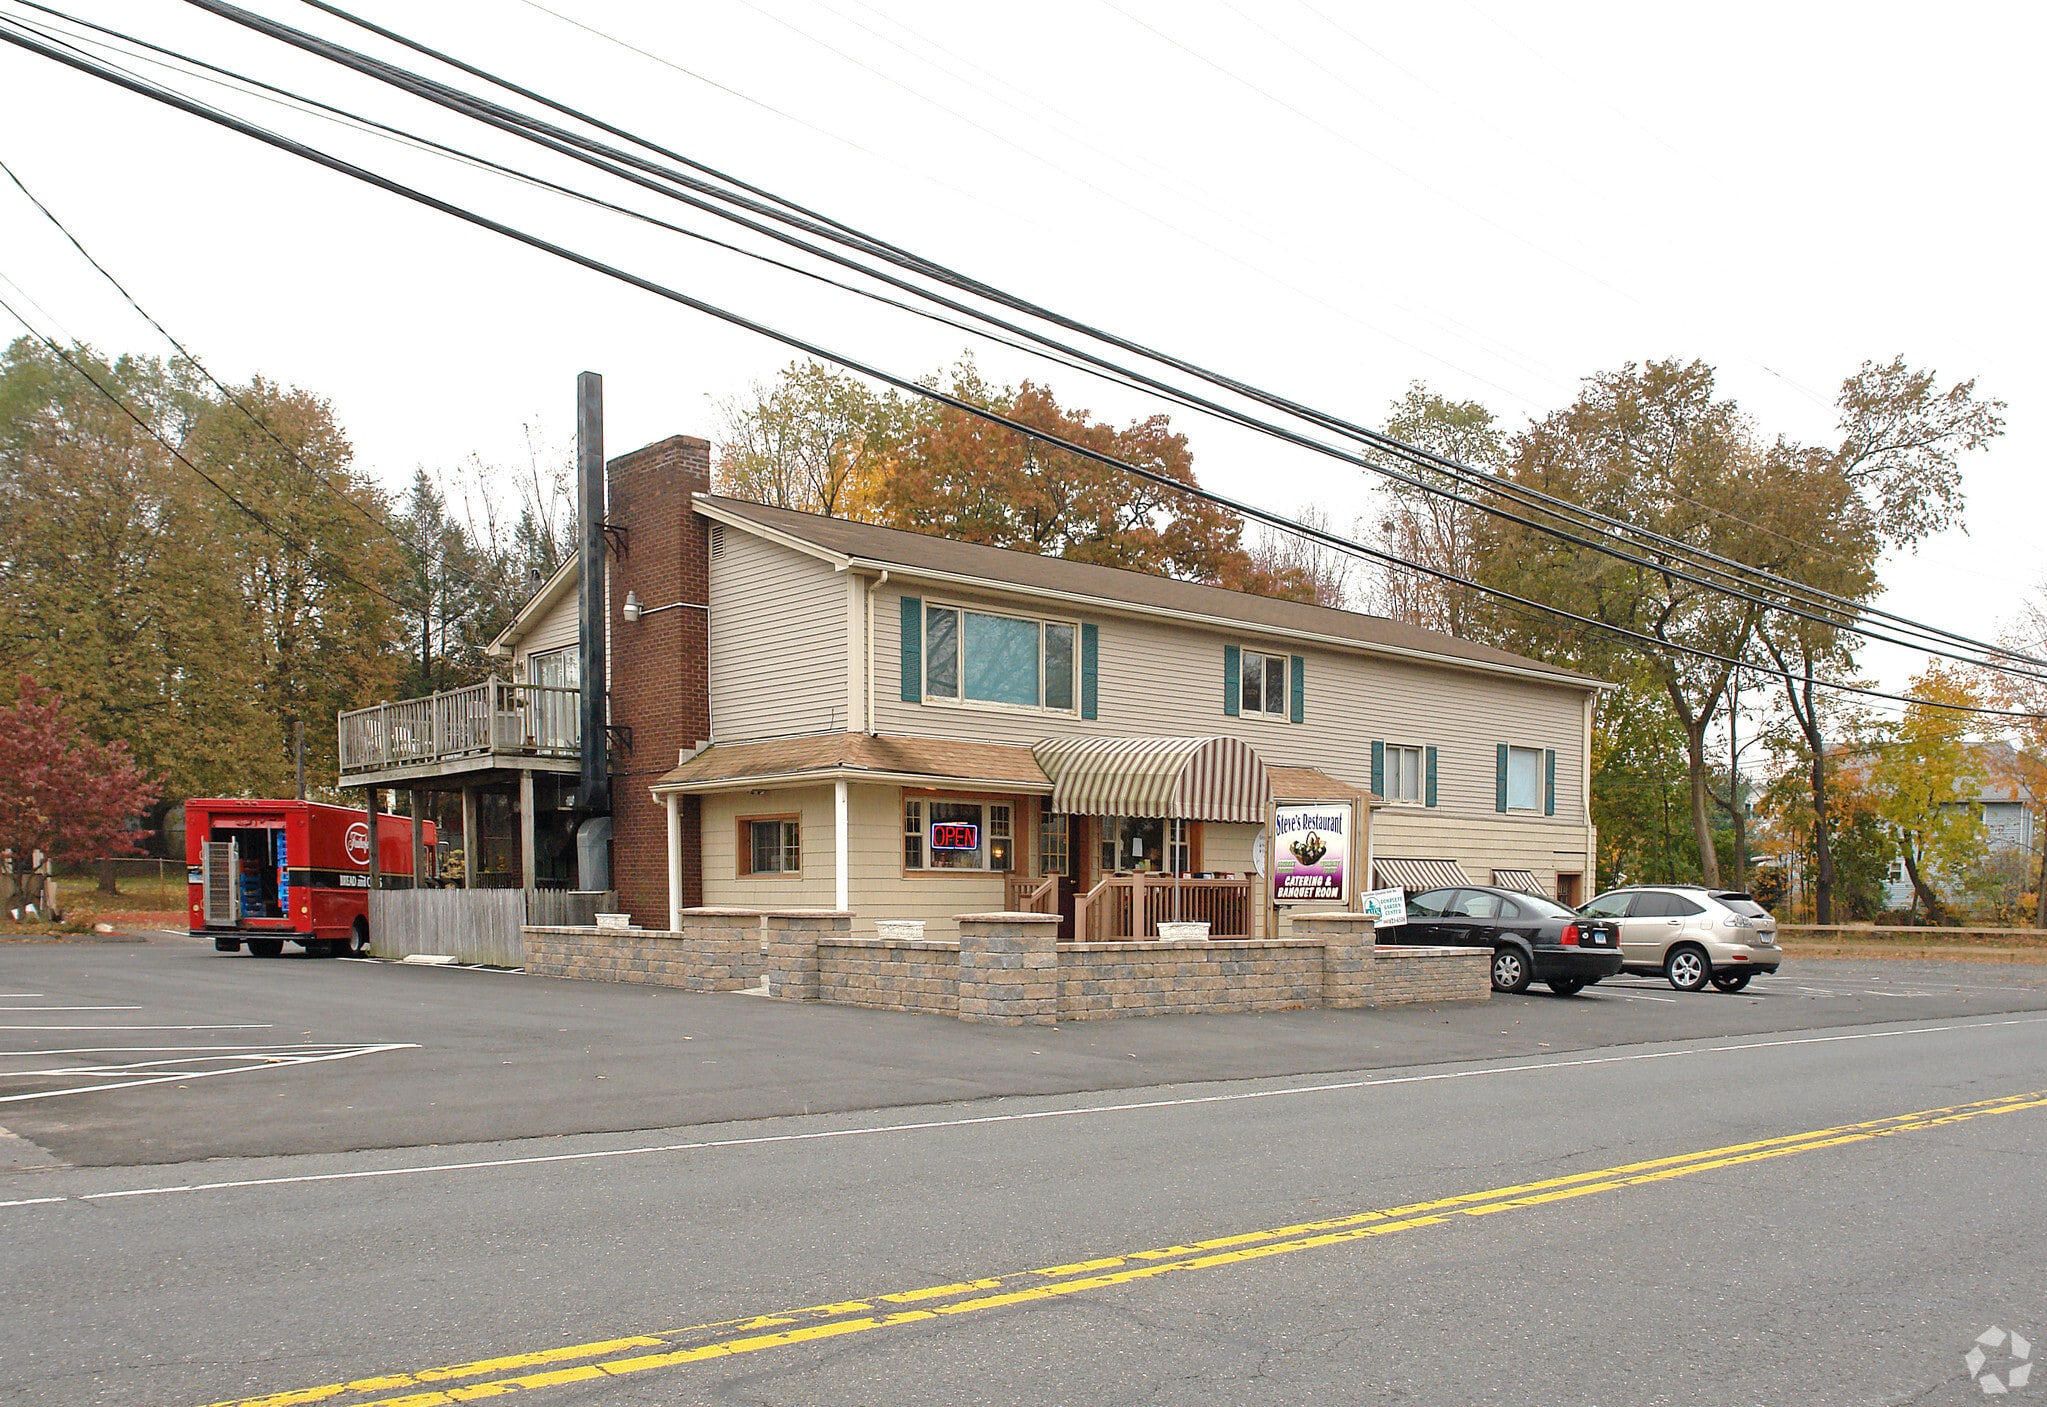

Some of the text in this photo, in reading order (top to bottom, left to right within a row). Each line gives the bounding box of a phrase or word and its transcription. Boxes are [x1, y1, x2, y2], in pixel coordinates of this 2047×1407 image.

[1276, 813, 1343, 836] Steve's Restaurant
[933, 825, 976, 848] OPEN
[340, 874, 357, 887] BREAD
[1284, 875, 1332, 887] CATERING &
[1277, 887, 1339, 898] BANQUET ROOM
